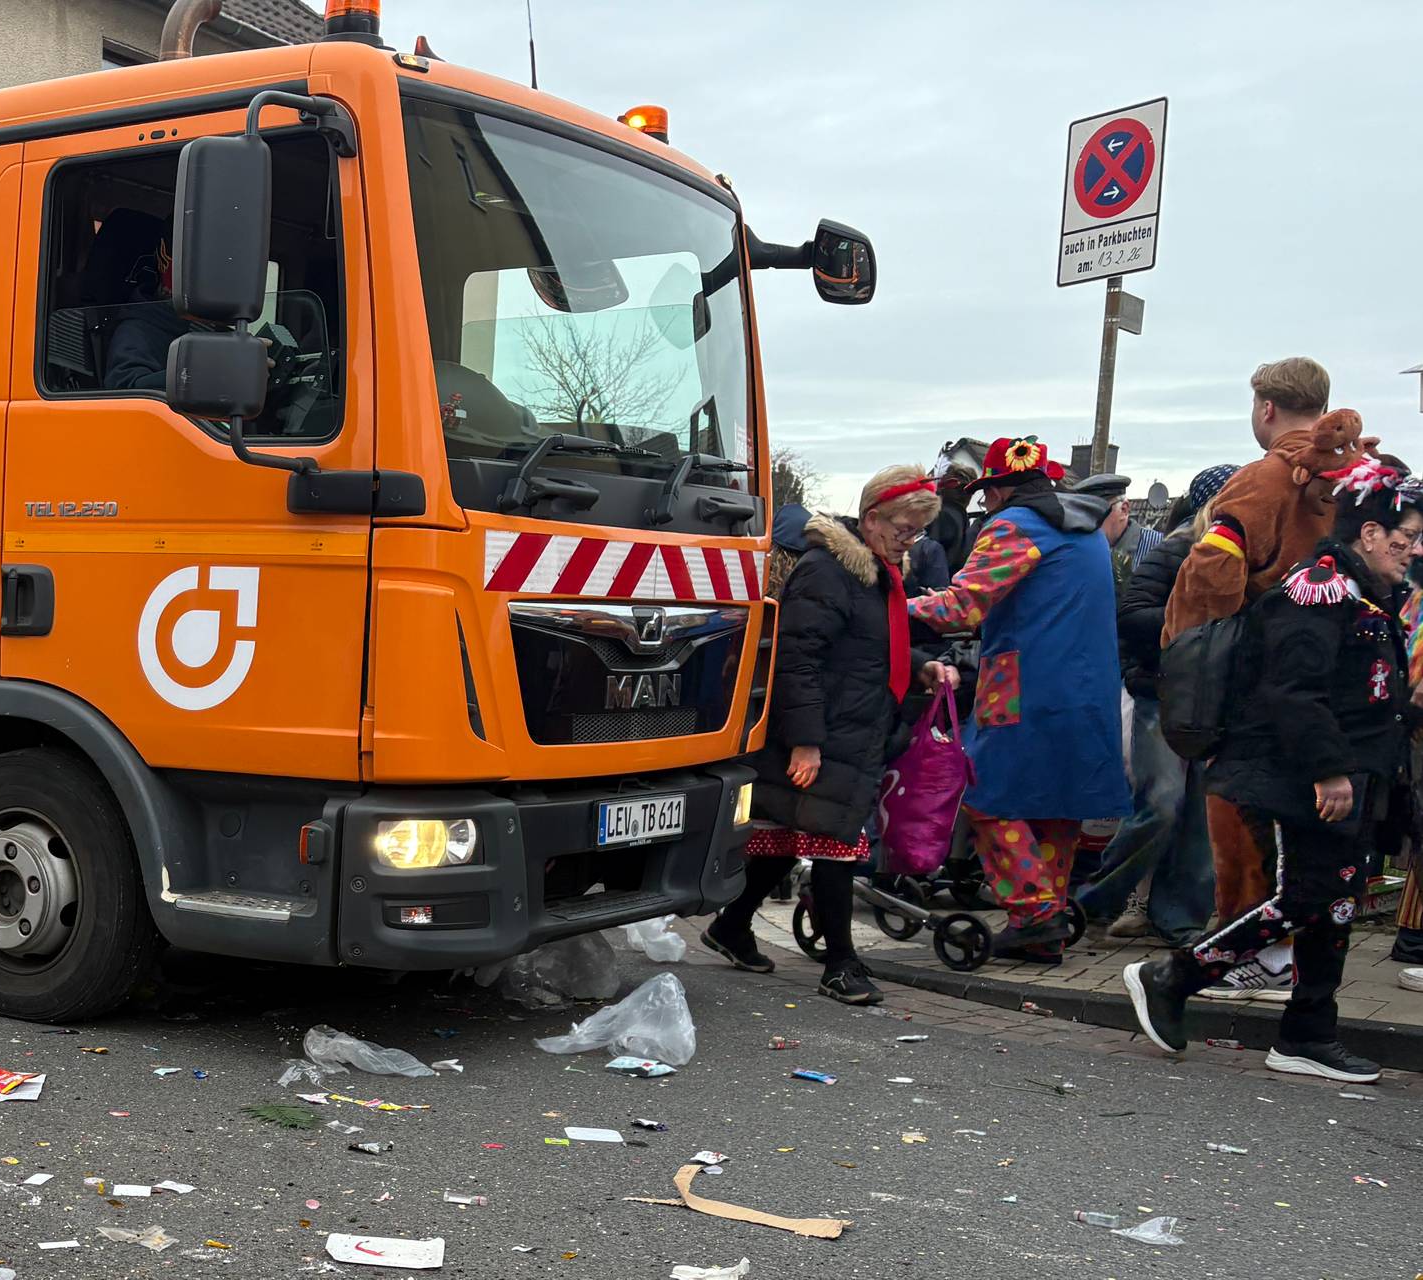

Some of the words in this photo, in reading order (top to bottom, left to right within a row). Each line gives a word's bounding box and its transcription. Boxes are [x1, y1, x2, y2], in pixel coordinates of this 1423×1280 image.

[1064, 238, 1085, 256] auch
[1087, 236, 1095, 251] in
[1097, 226, 1152, 249] Parkbuchten
[1077, 260, 1093, 274] am:
[605, 673, 681, 709] MAN
[607, 806, 632, 837] LEV
[642, 803, 657, 832] TB
[658, 800, 681, 830] 611
